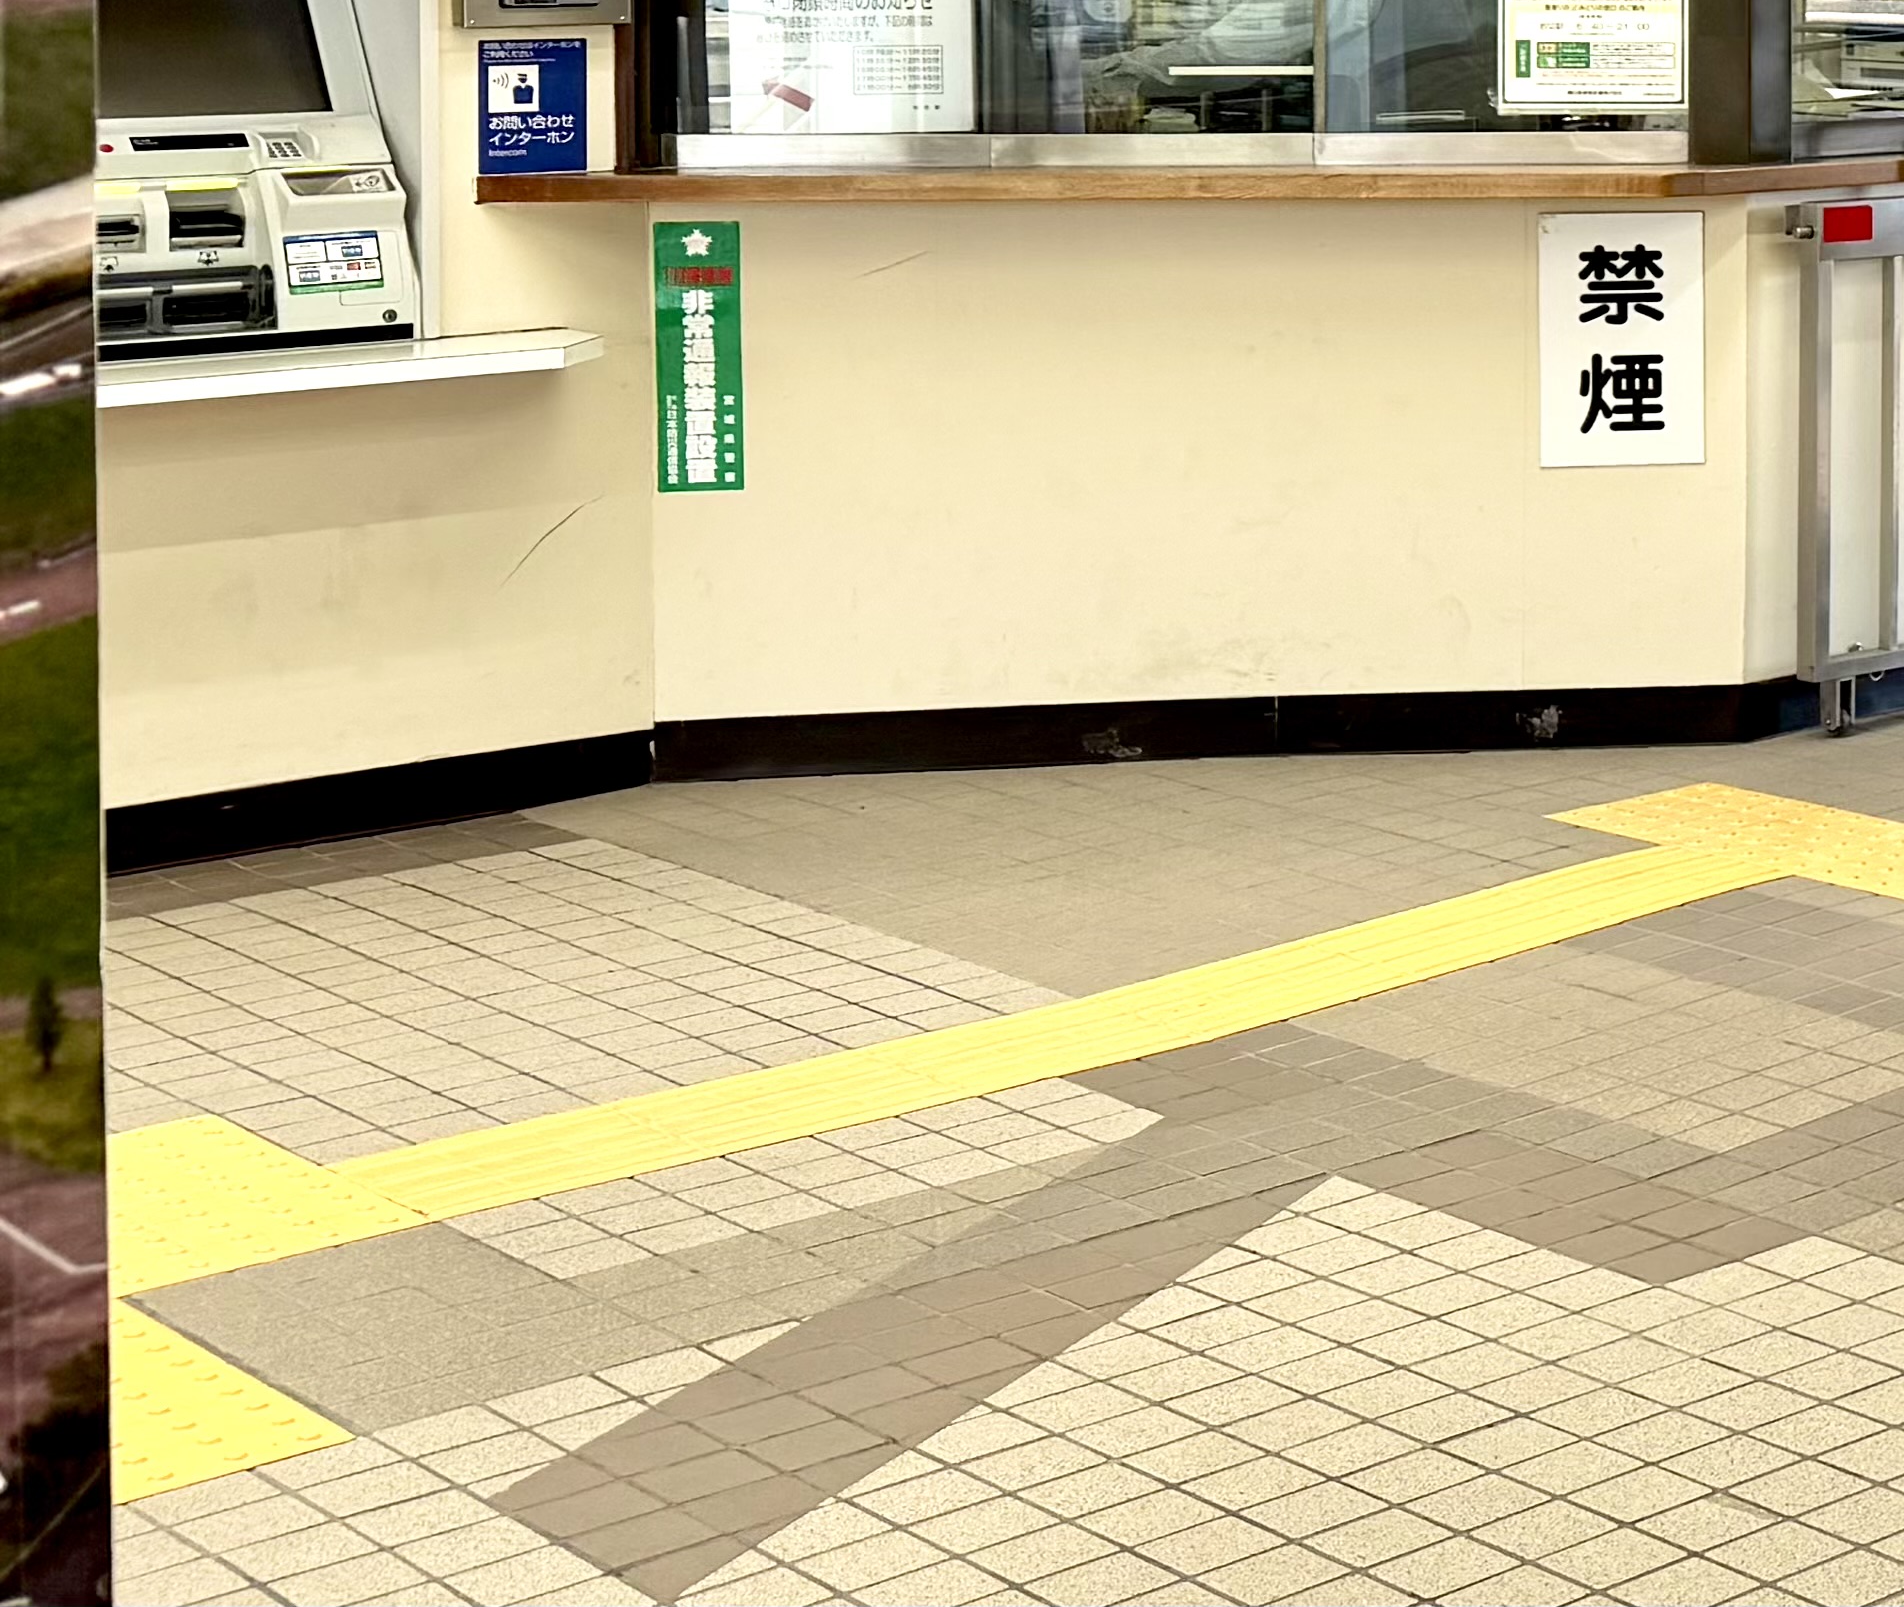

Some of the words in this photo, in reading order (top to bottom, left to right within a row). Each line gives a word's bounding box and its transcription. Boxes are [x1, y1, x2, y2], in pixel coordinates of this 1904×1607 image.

[488, 114, 576, 130] お問い合わせ
[488, 131, 575, 146] インターホン
[1577, 243, 1666, 435] 禁煙
